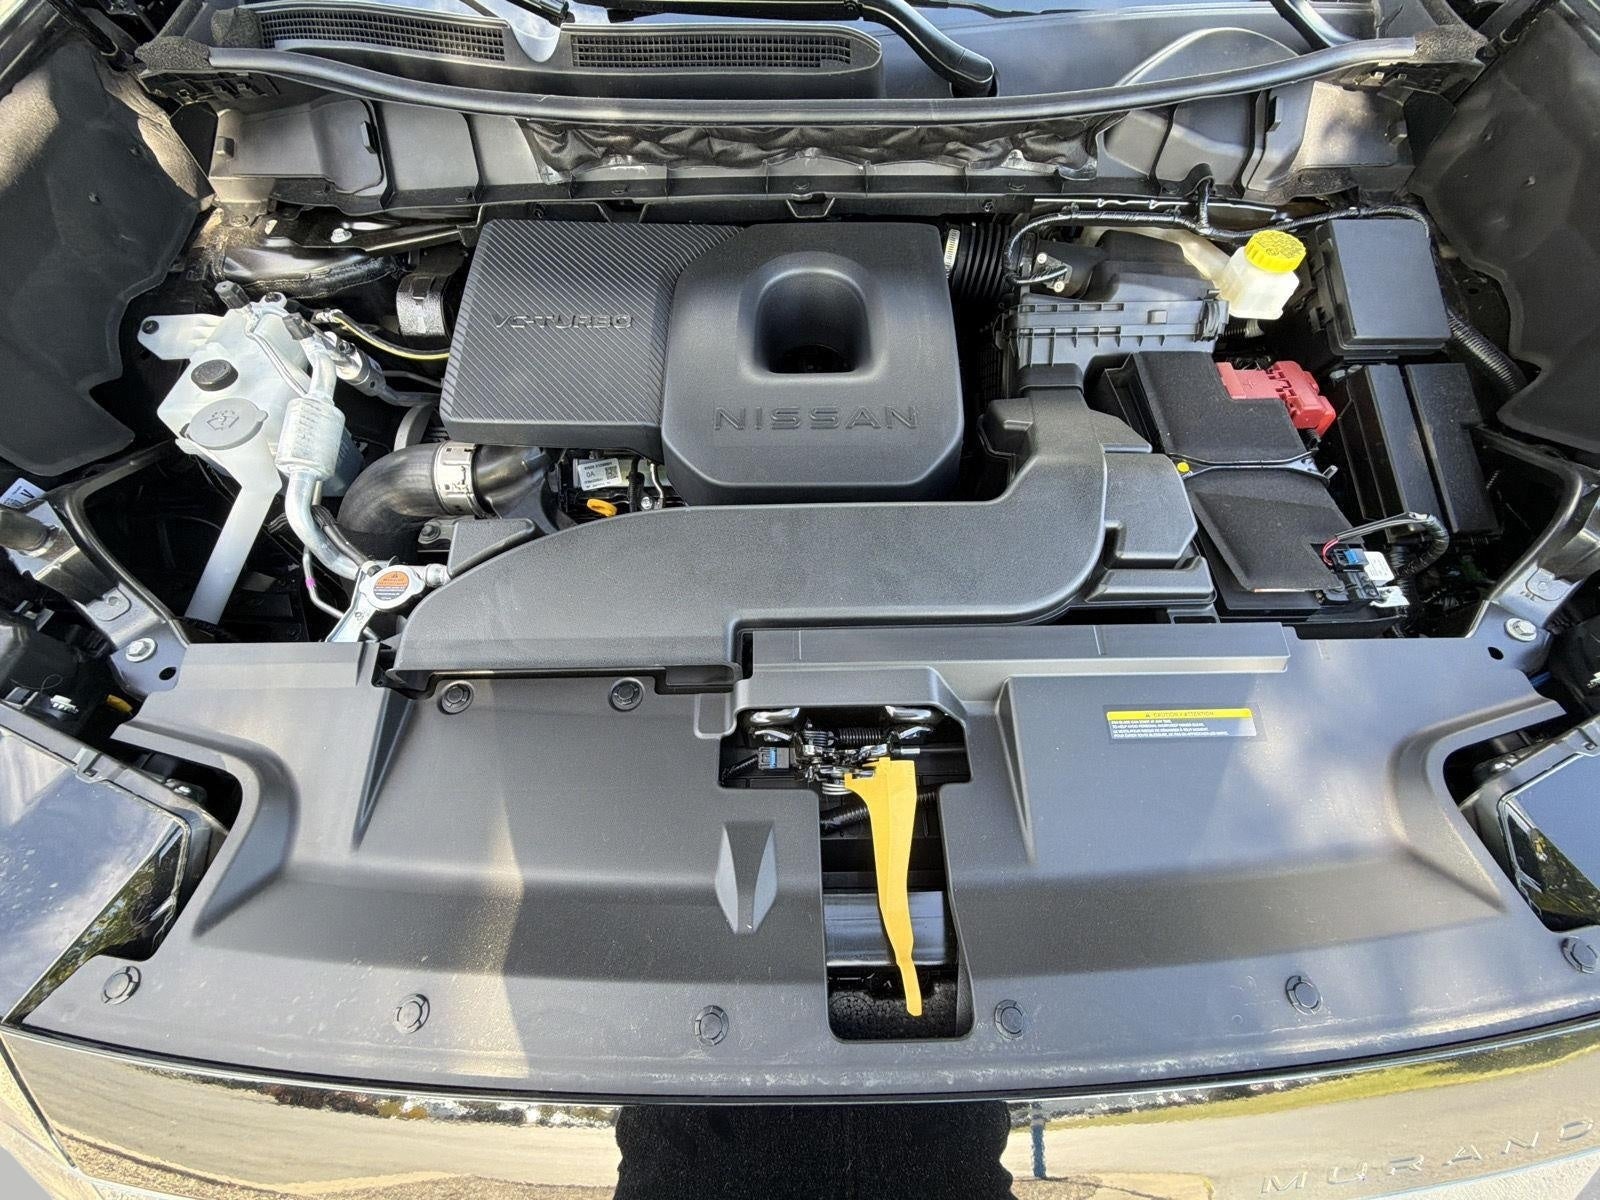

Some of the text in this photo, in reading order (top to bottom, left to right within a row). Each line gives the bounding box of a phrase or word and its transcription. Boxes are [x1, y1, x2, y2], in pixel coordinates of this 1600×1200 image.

[490, 313, 632, 329] VC-TURBO
[714, 406, 919, 430] NISSAN
[1261, 1119, 1594, 1194] MURANO
